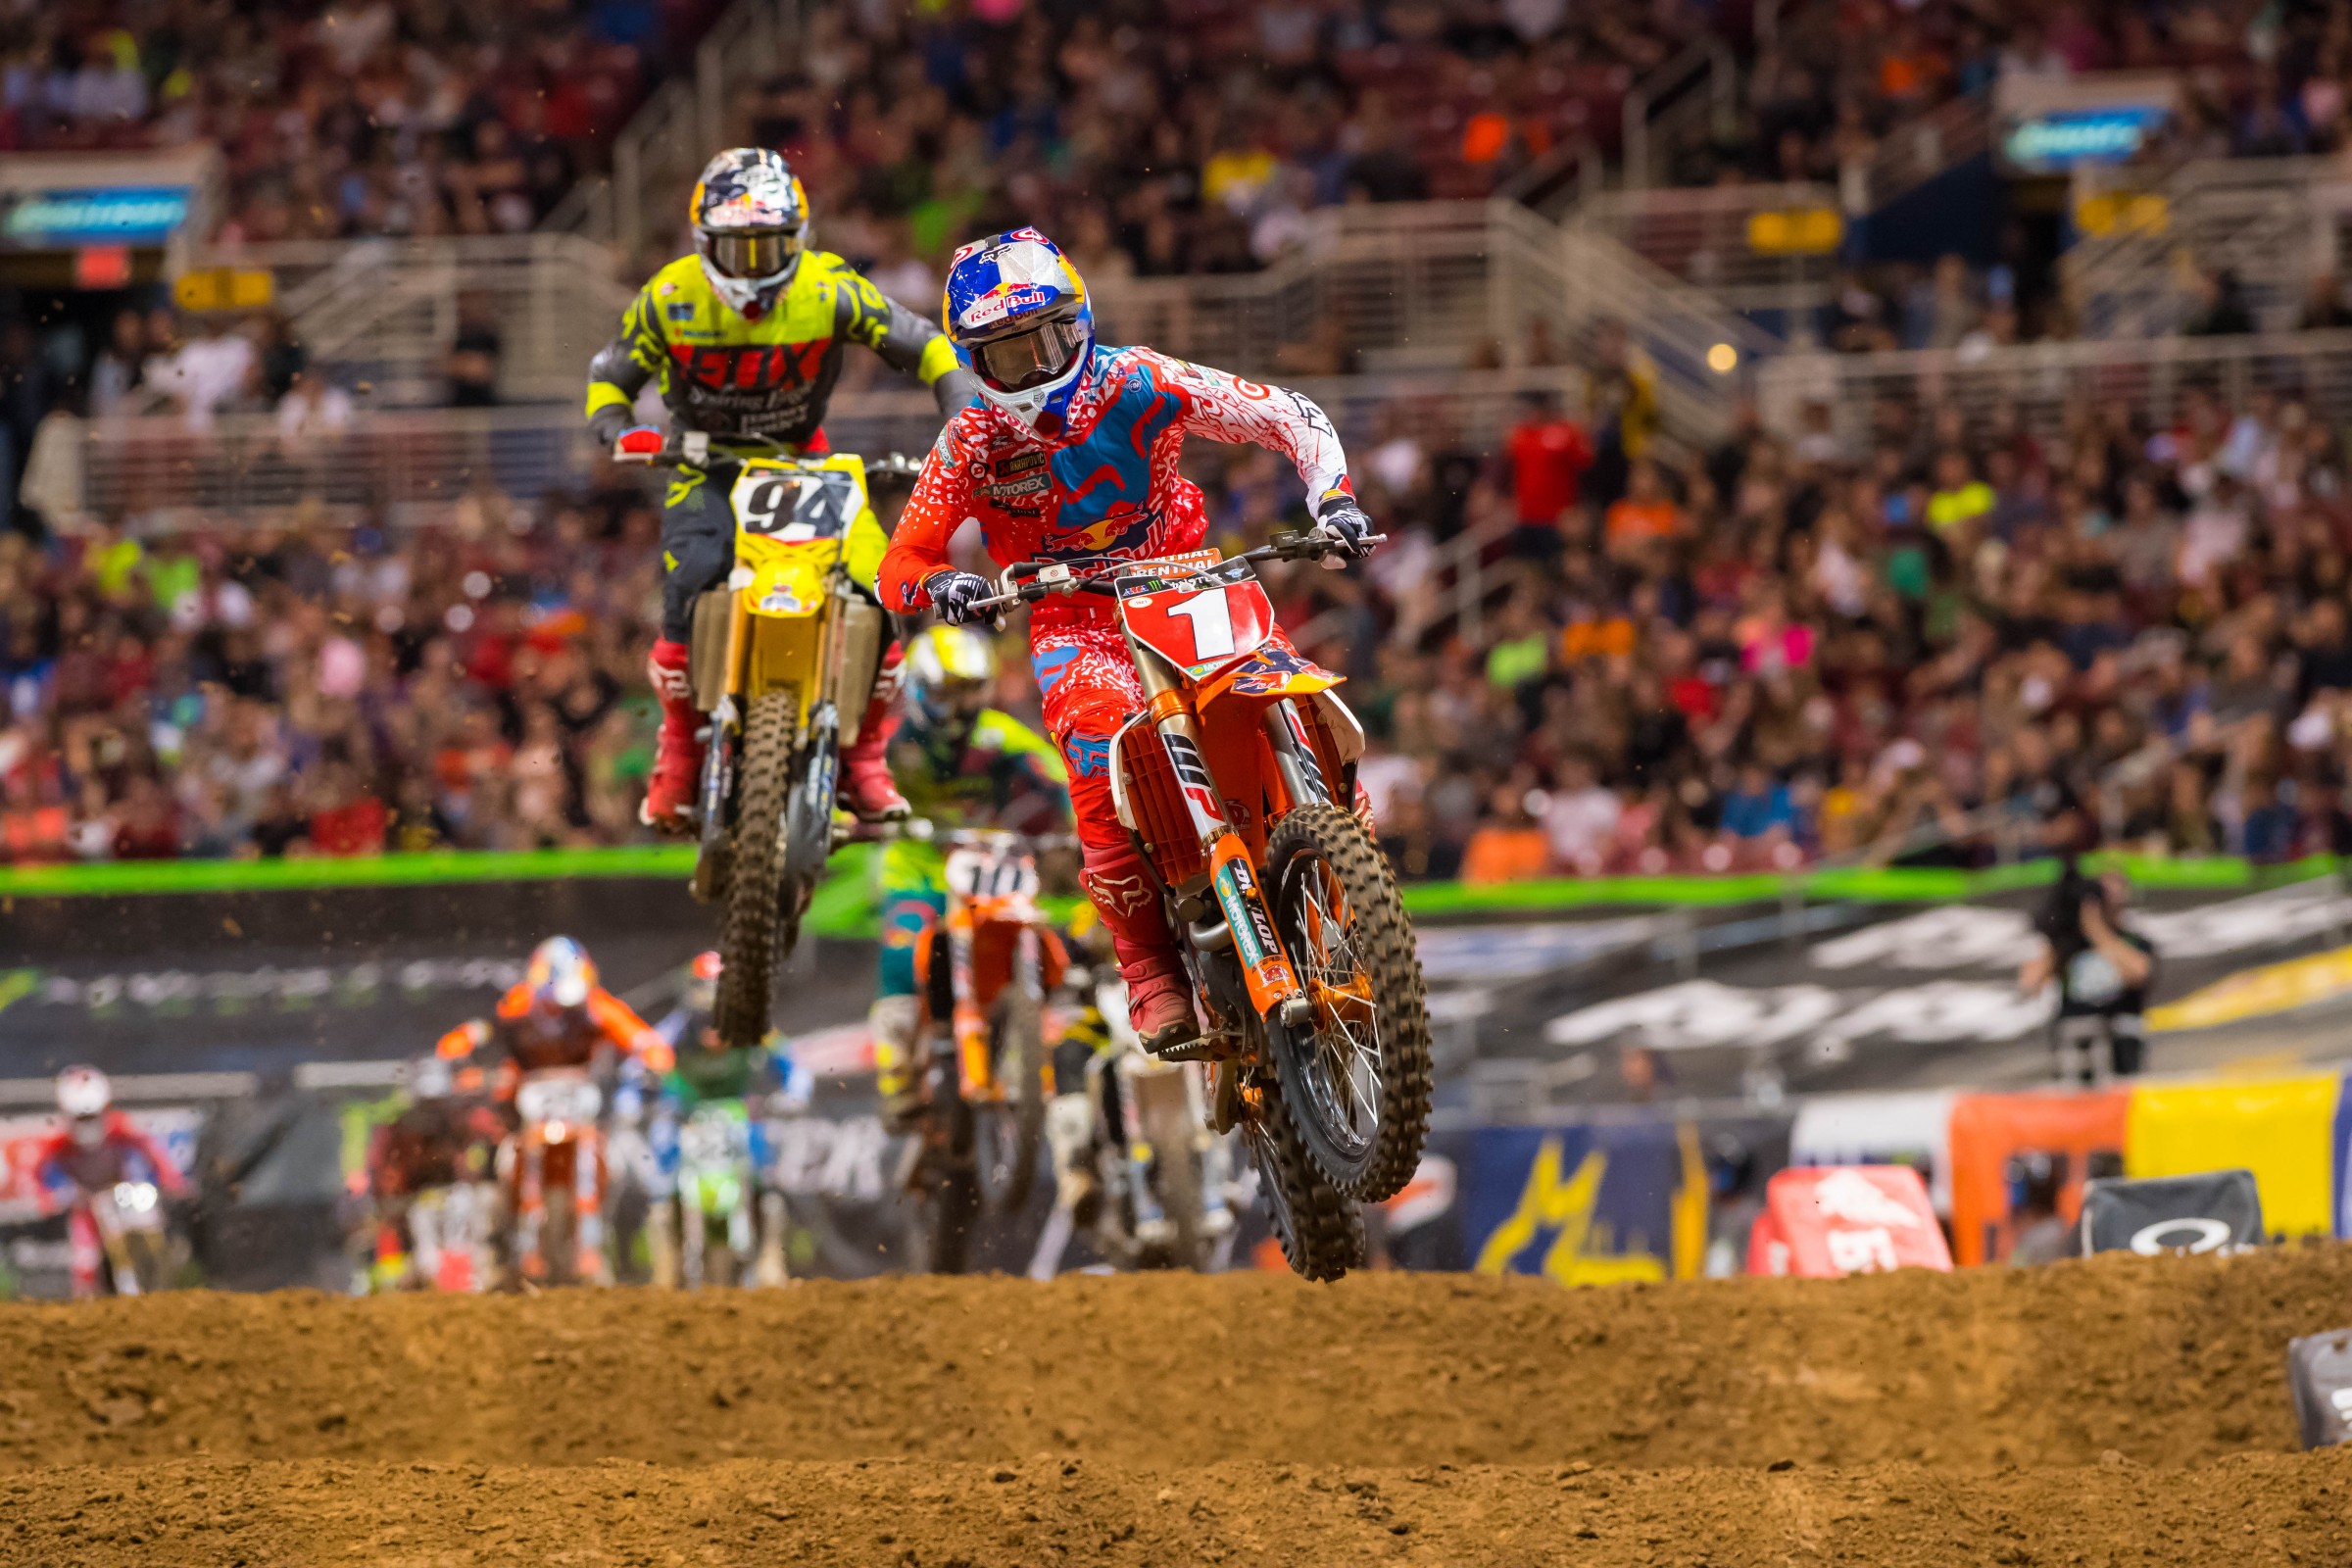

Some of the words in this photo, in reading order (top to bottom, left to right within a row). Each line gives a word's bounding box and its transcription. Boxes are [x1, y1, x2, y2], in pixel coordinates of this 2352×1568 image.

[969, 298, 1005, 322] Red
[1005, 291, 1046, 309] Bull
[745, 480, 852, 538] 94
[993, 476, 1046, 496] MOTOREX
[1134, 559, 1214, 576] RENTHAL
[1166, 587, 1236, 661] 1
[1226, 894, 1261, 964] MOTOREX
[1234, 866, 1280, 955] DULOP
